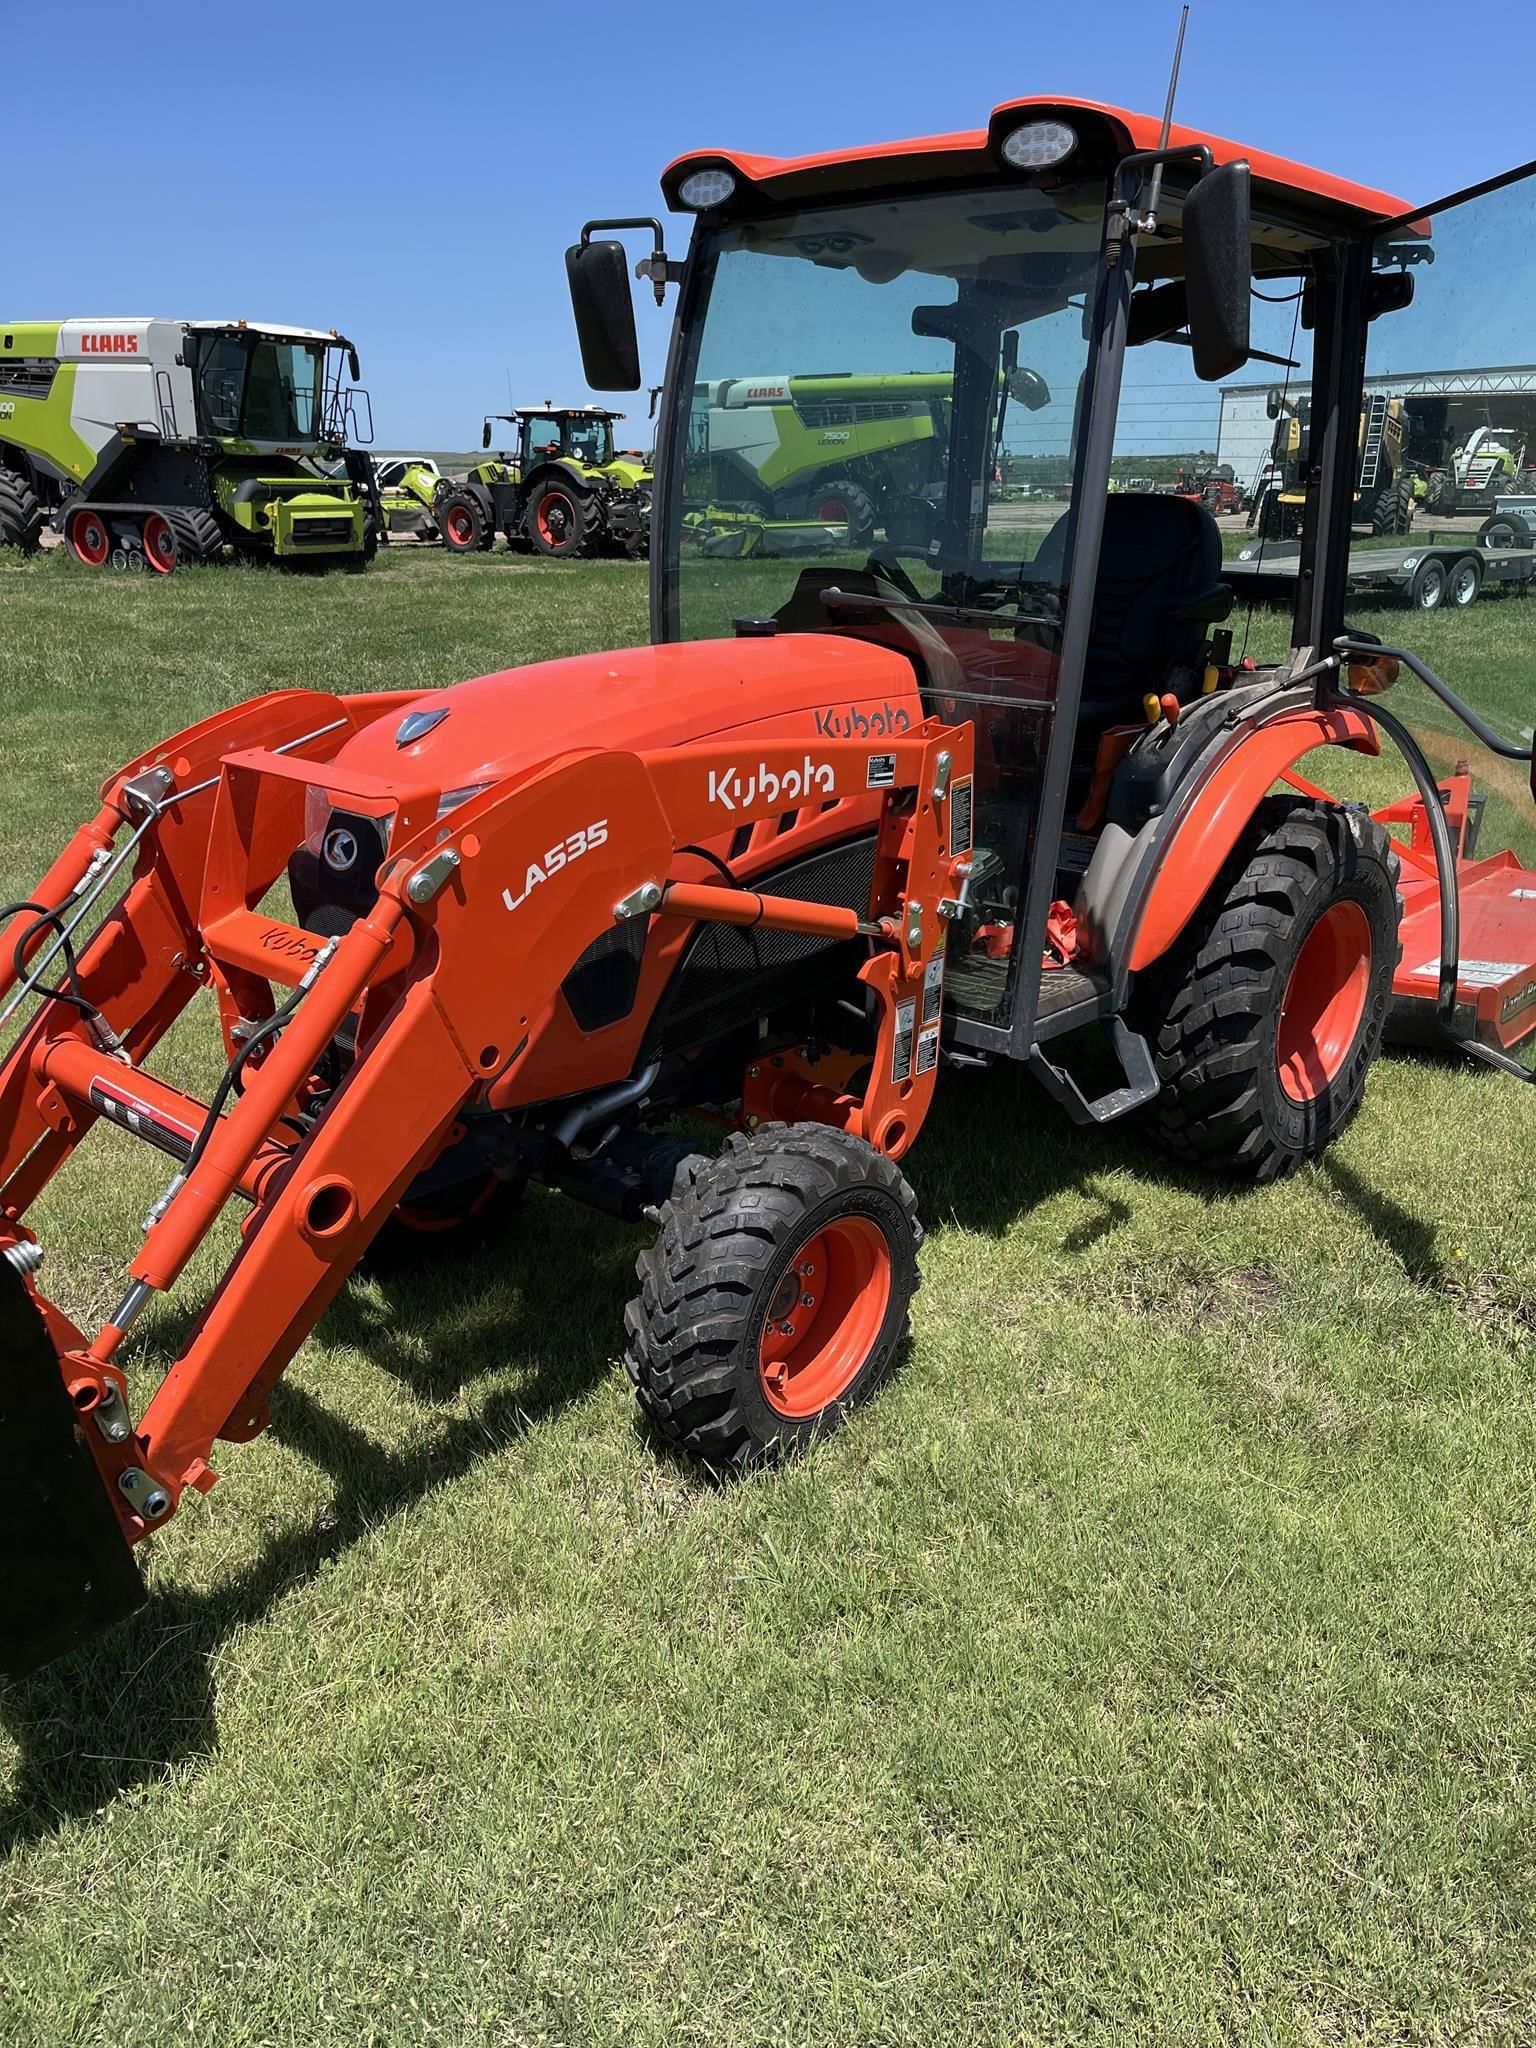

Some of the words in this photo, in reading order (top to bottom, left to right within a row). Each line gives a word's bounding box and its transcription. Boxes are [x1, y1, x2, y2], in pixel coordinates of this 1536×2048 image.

[81, 334, 138, 353] CLAAS
[746, 387, 784, 398] CLAAS
[0, 402, 15, 412] 00
[823, 431, 850, 440] 7500
[814, 702, 911, 739] Kubota
[708, 755, 835, 810] Kubota
[502, 818, 608, 911] LA535
[260, 928, 320, 965] Kubo
